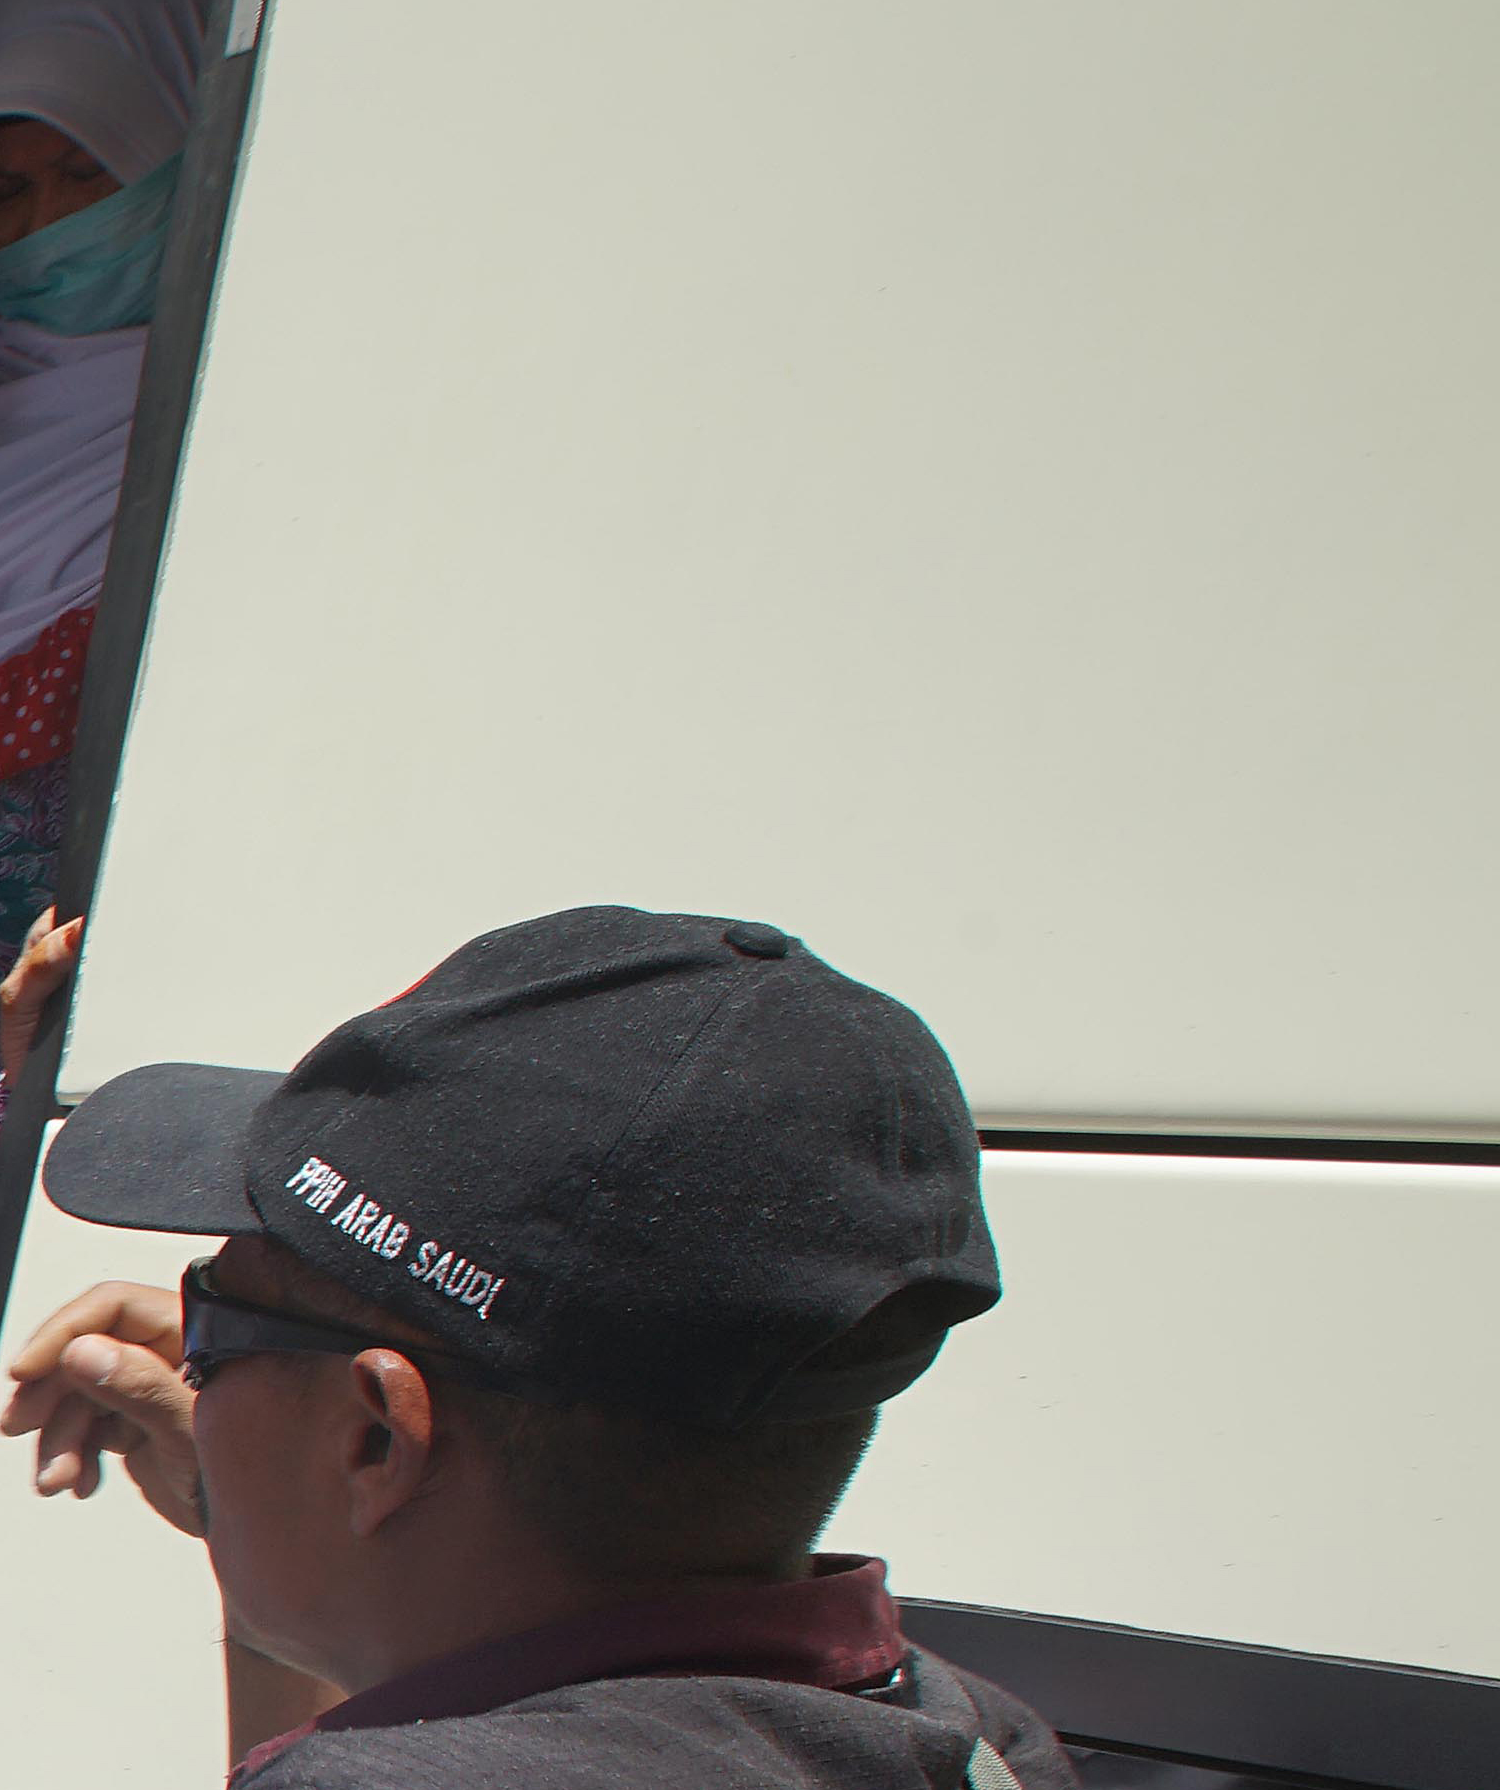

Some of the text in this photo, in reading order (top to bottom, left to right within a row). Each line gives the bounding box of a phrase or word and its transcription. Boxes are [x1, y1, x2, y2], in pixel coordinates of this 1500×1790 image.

[285, 1156, 507, 1321] PPIH ARAB SAUDI
